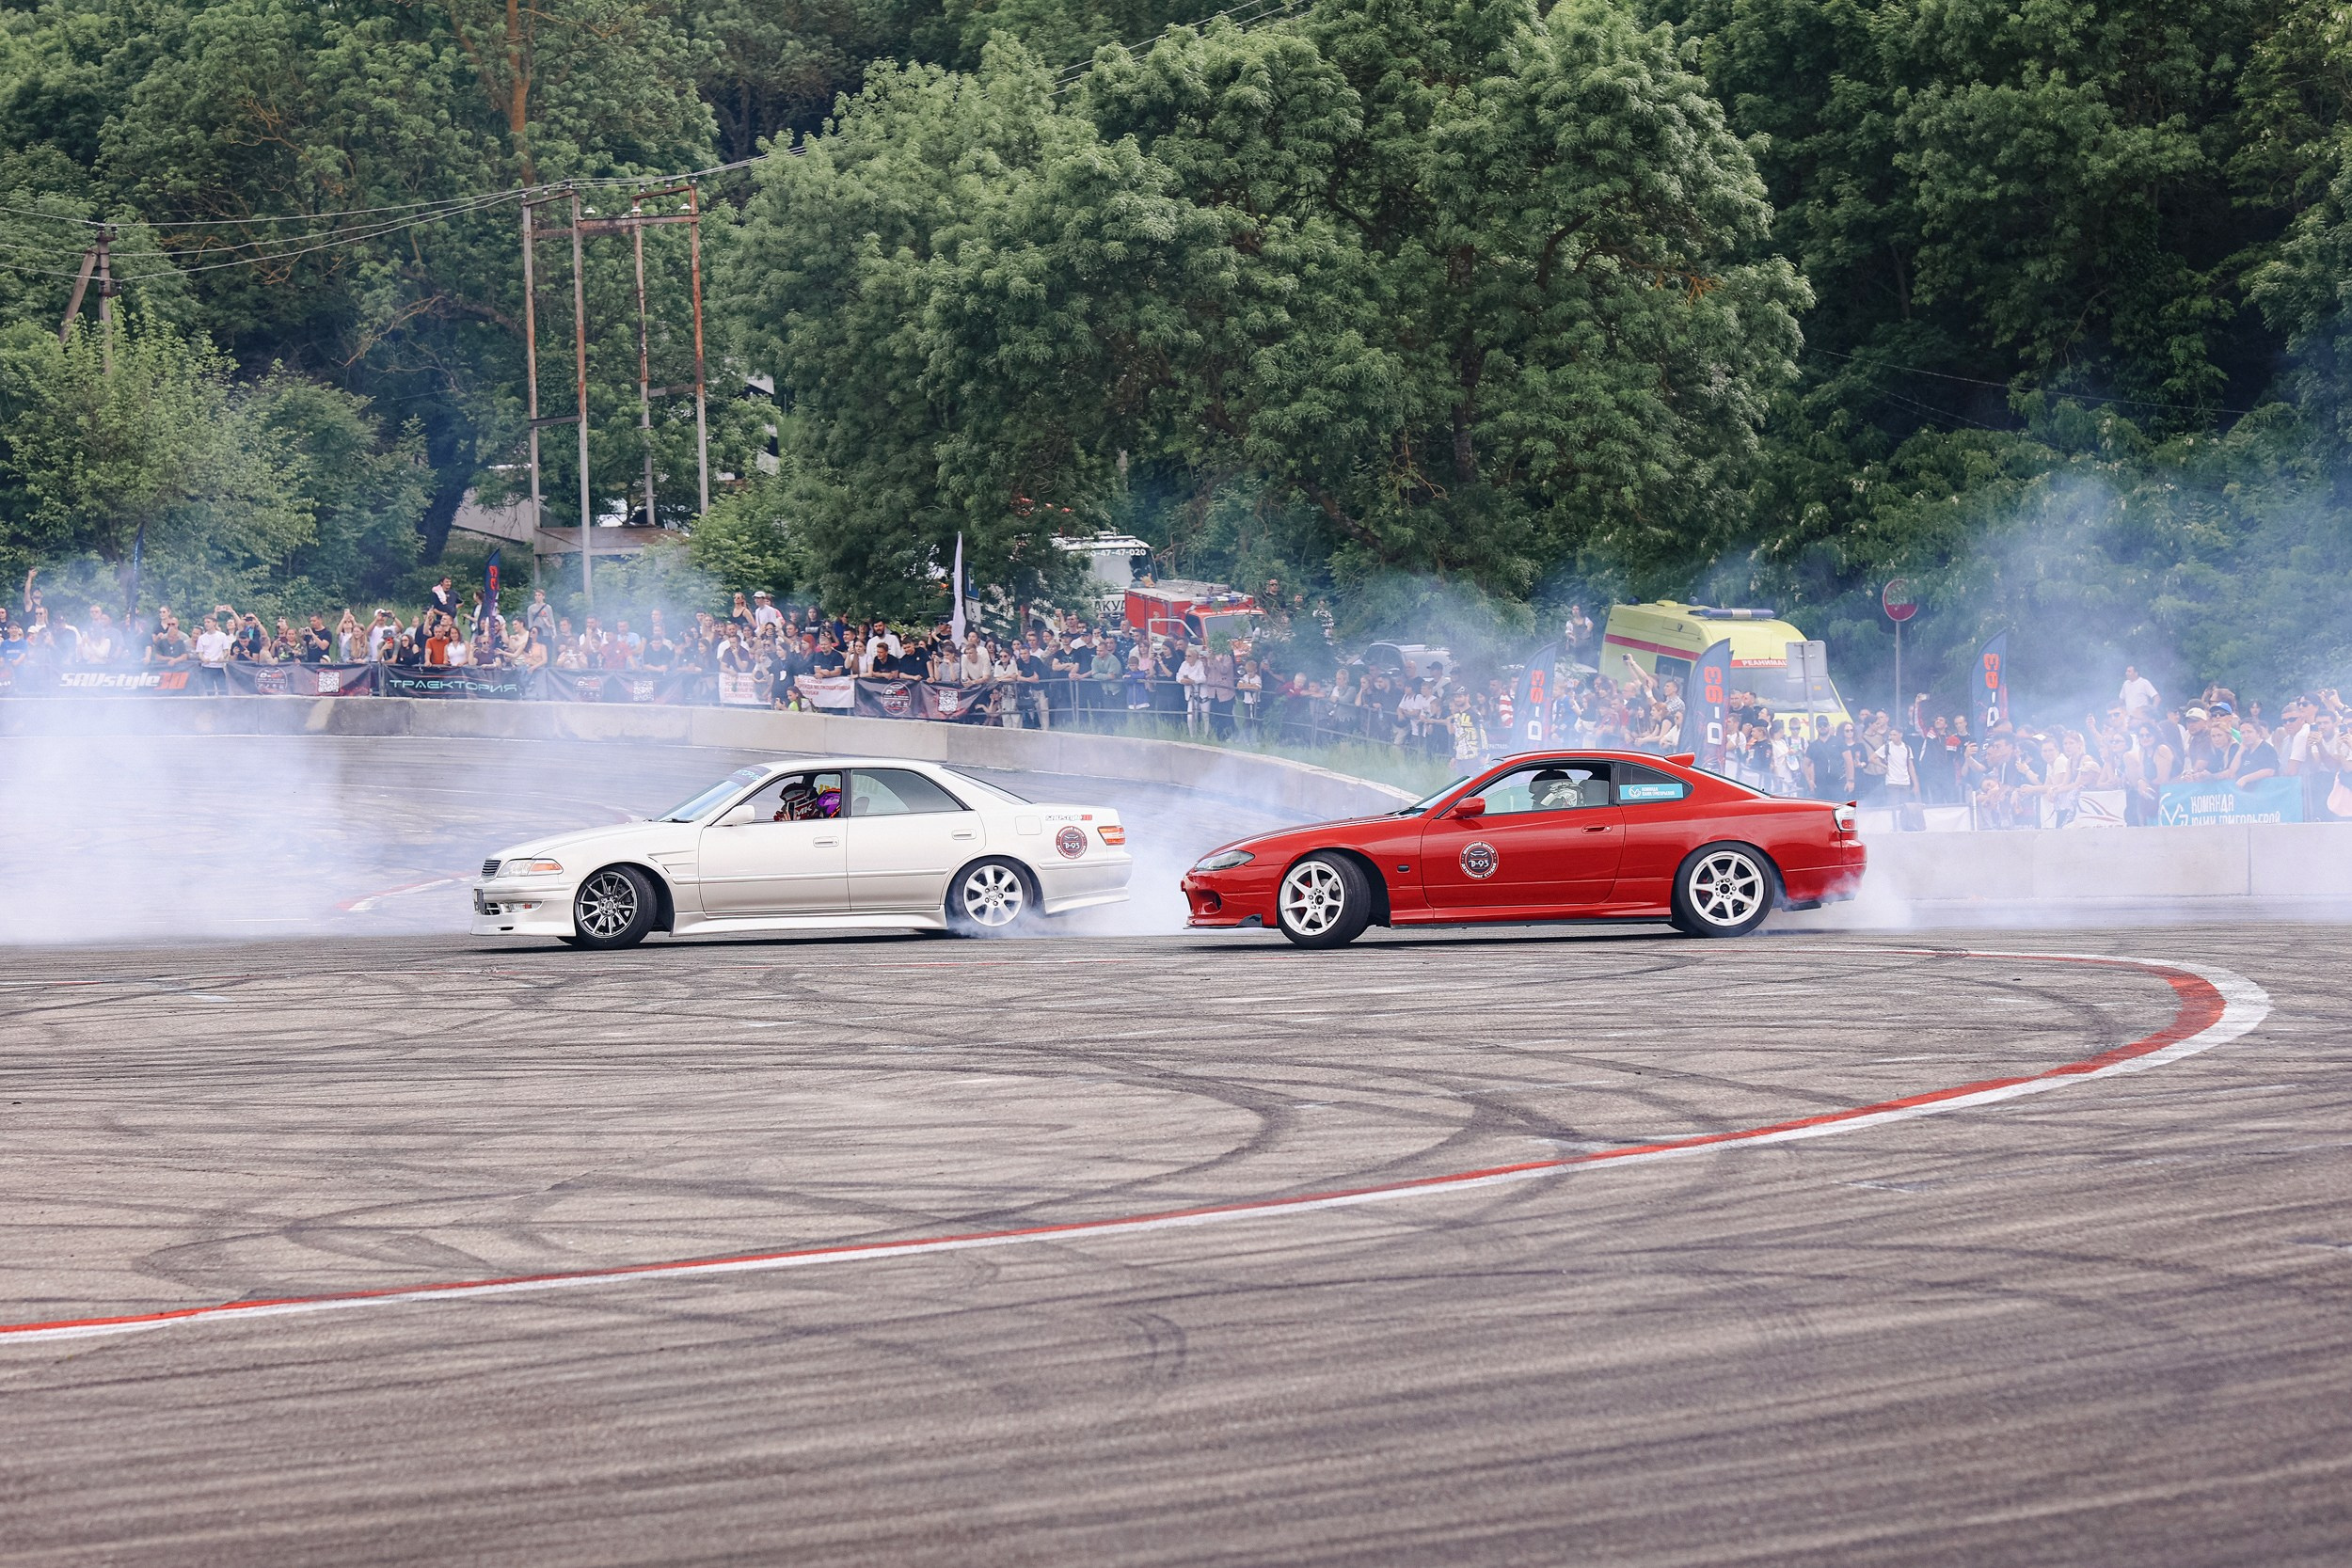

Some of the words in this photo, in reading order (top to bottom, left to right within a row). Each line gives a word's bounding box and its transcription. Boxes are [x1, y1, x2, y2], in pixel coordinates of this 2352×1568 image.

[389, 679, 516, 693] ТРАЕКТОРИЯ
[1528, 670, 1545, 741] D-93
[1704, 666, 1723, 745] D-93
[2190, 794, 2234, 814] КОМАНДА
